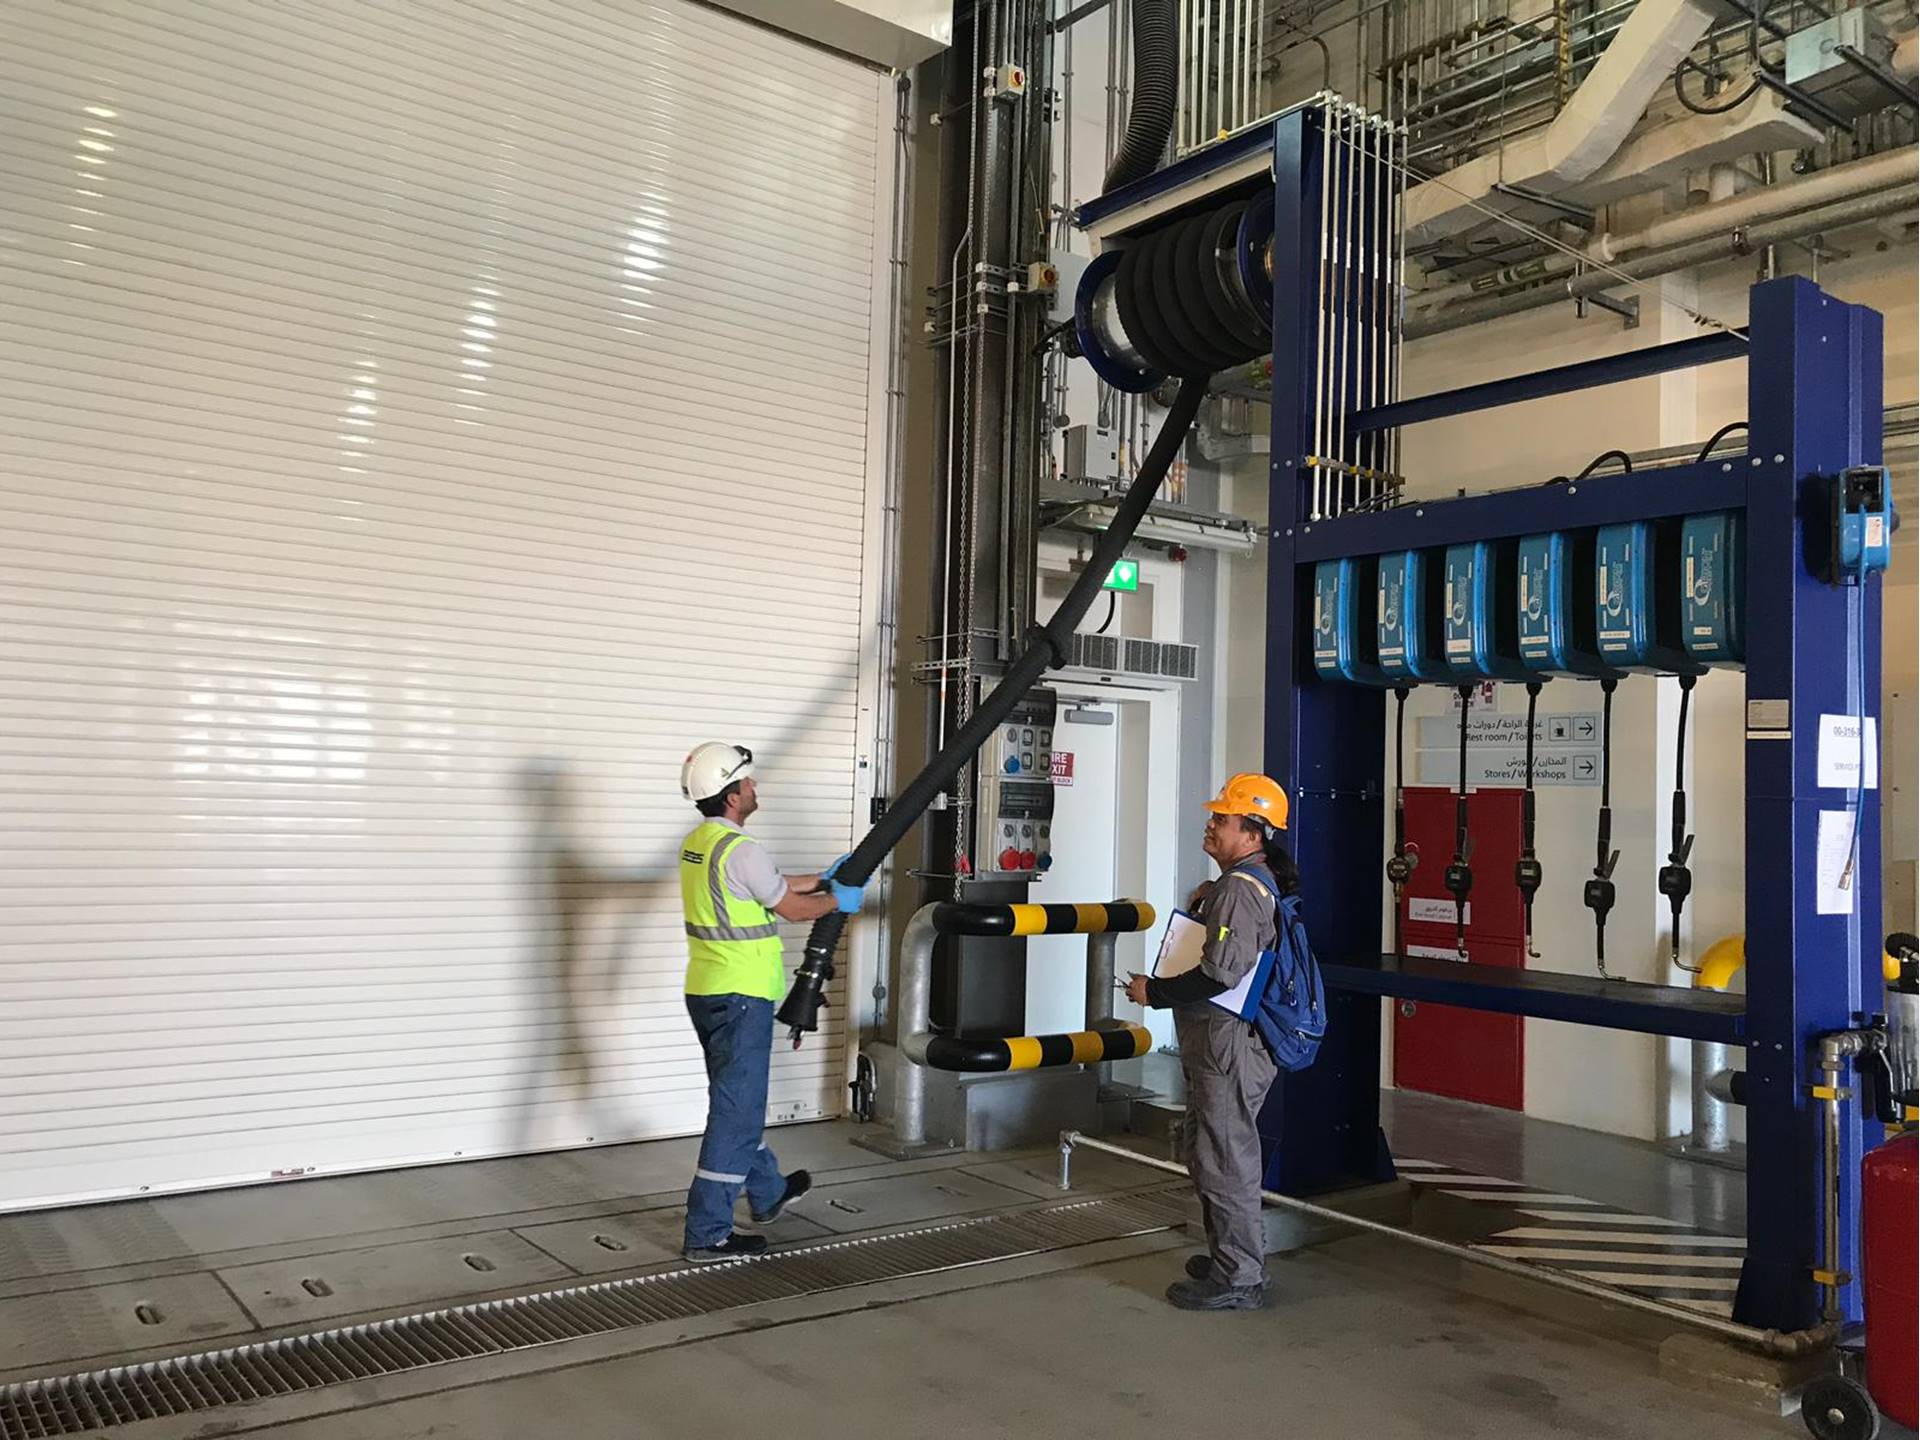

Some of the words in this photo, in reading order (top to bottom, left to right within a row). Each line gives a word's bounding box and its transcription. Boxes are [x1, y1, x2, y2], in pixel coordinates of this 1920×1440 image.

[1466, 733, 1483, 741] Rest
[1515, 732, 1543, 741] Toits
[1051, 752, 1068, 764] IRE
[1051, 763, 1067, 775] XIT
[1484, 769, 1510, 778] Stores
[1518, 769, 1566, 780] Wrkshops
